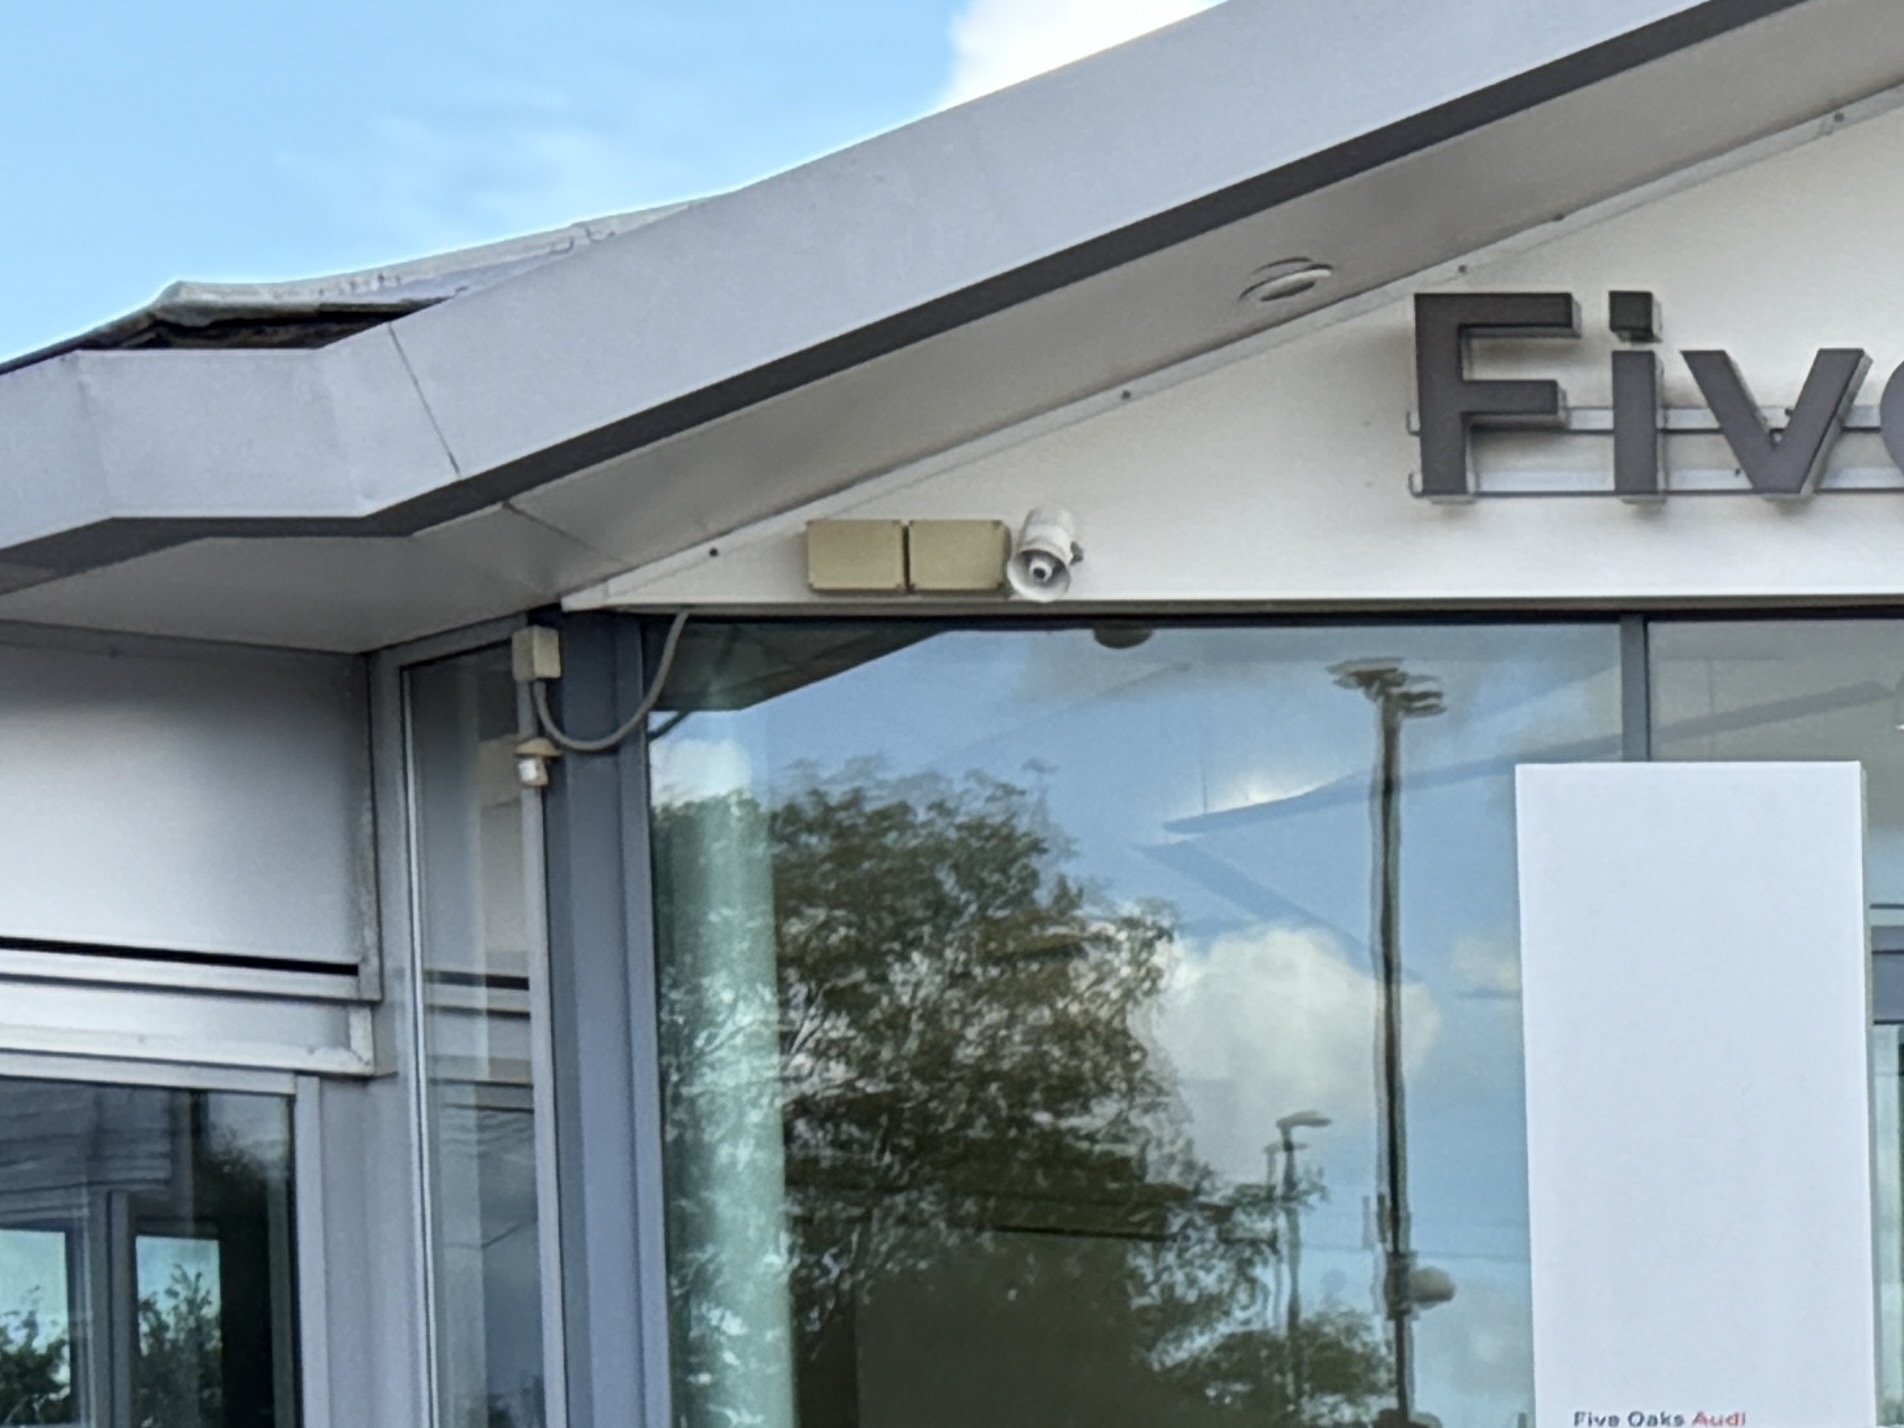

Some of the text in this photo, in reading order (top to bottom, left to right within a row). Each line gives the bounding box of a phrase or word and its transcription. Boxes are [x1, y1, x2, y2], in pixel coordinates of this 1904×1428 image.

[1573, 1411, 1747, 1427] Five Oaks Audi
